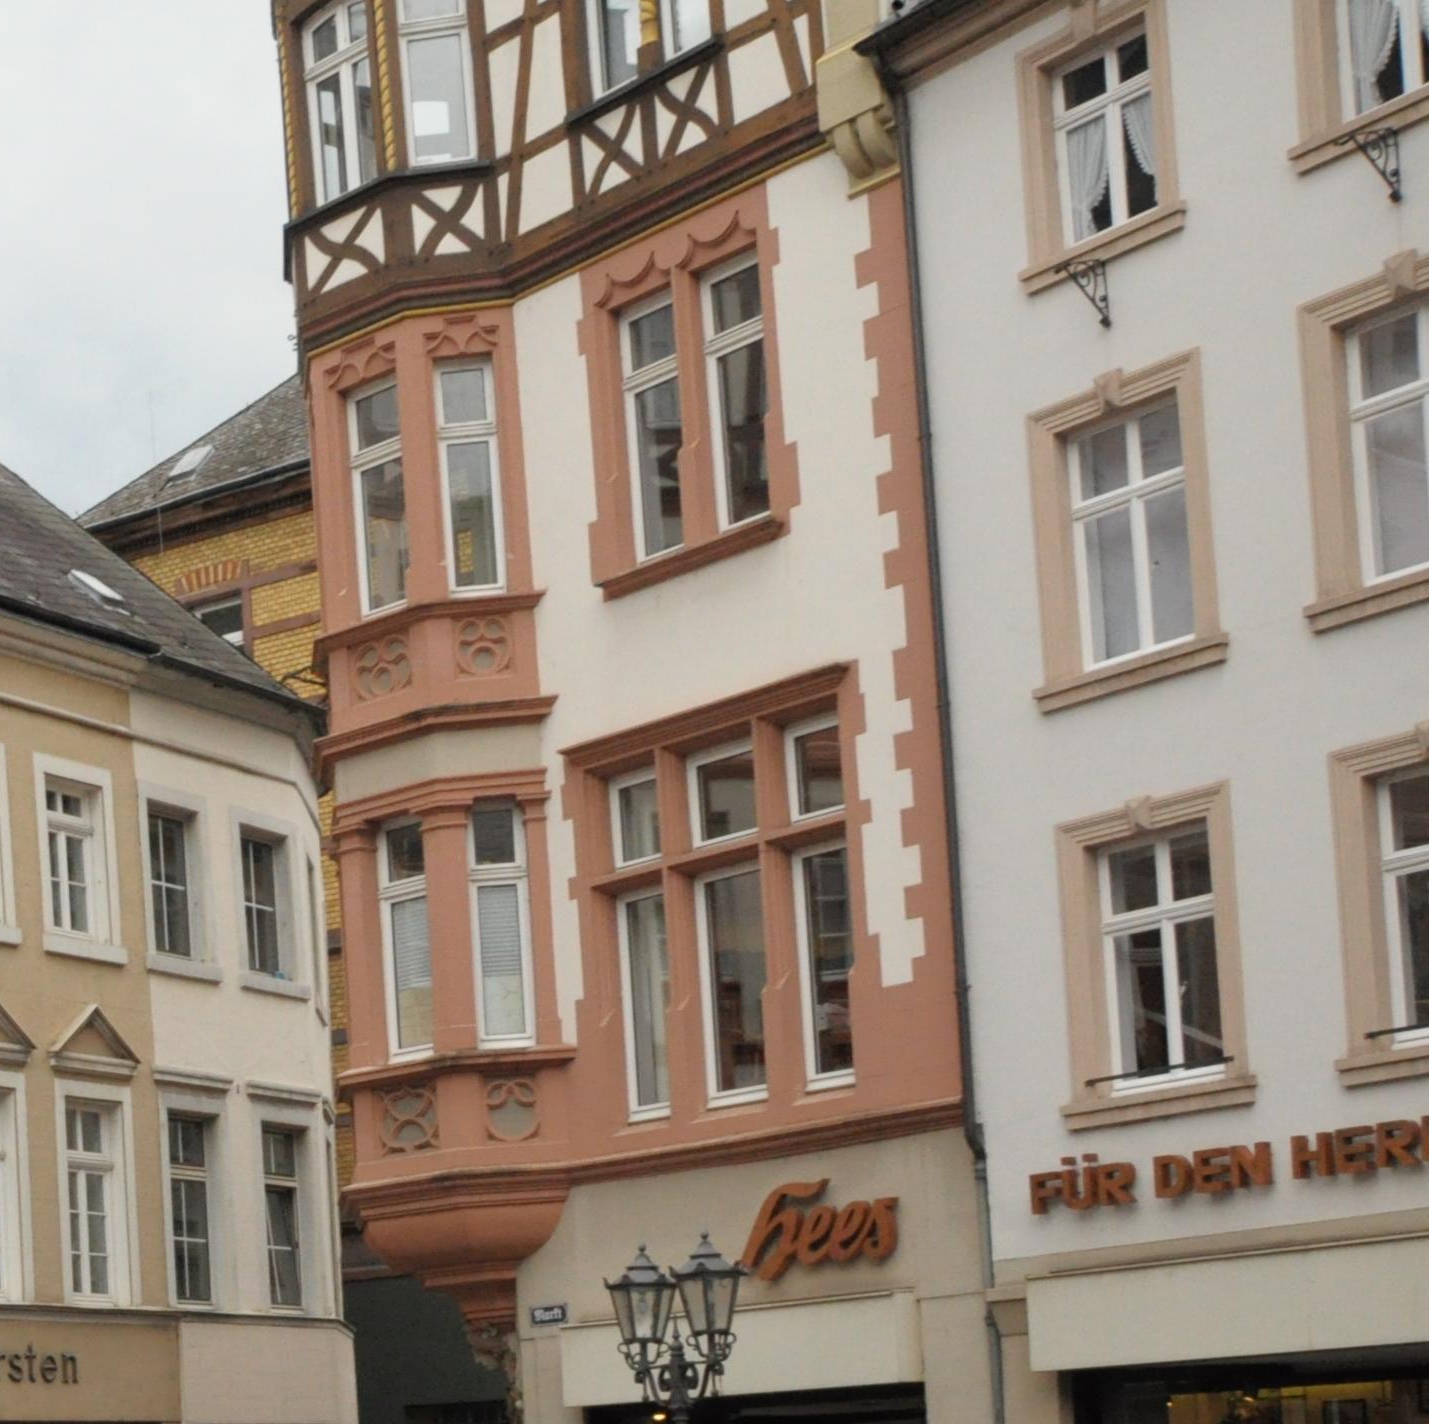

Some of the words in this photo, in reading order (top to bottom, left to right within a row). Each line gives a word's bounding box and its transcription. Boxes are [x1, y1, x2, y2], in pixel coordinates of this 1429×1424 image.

[1028, 1152, 1138, 1216] FÜR
[1152, 1140, 1274, 1199] DEN
[1290, 1113, 1429, 1180] HER
